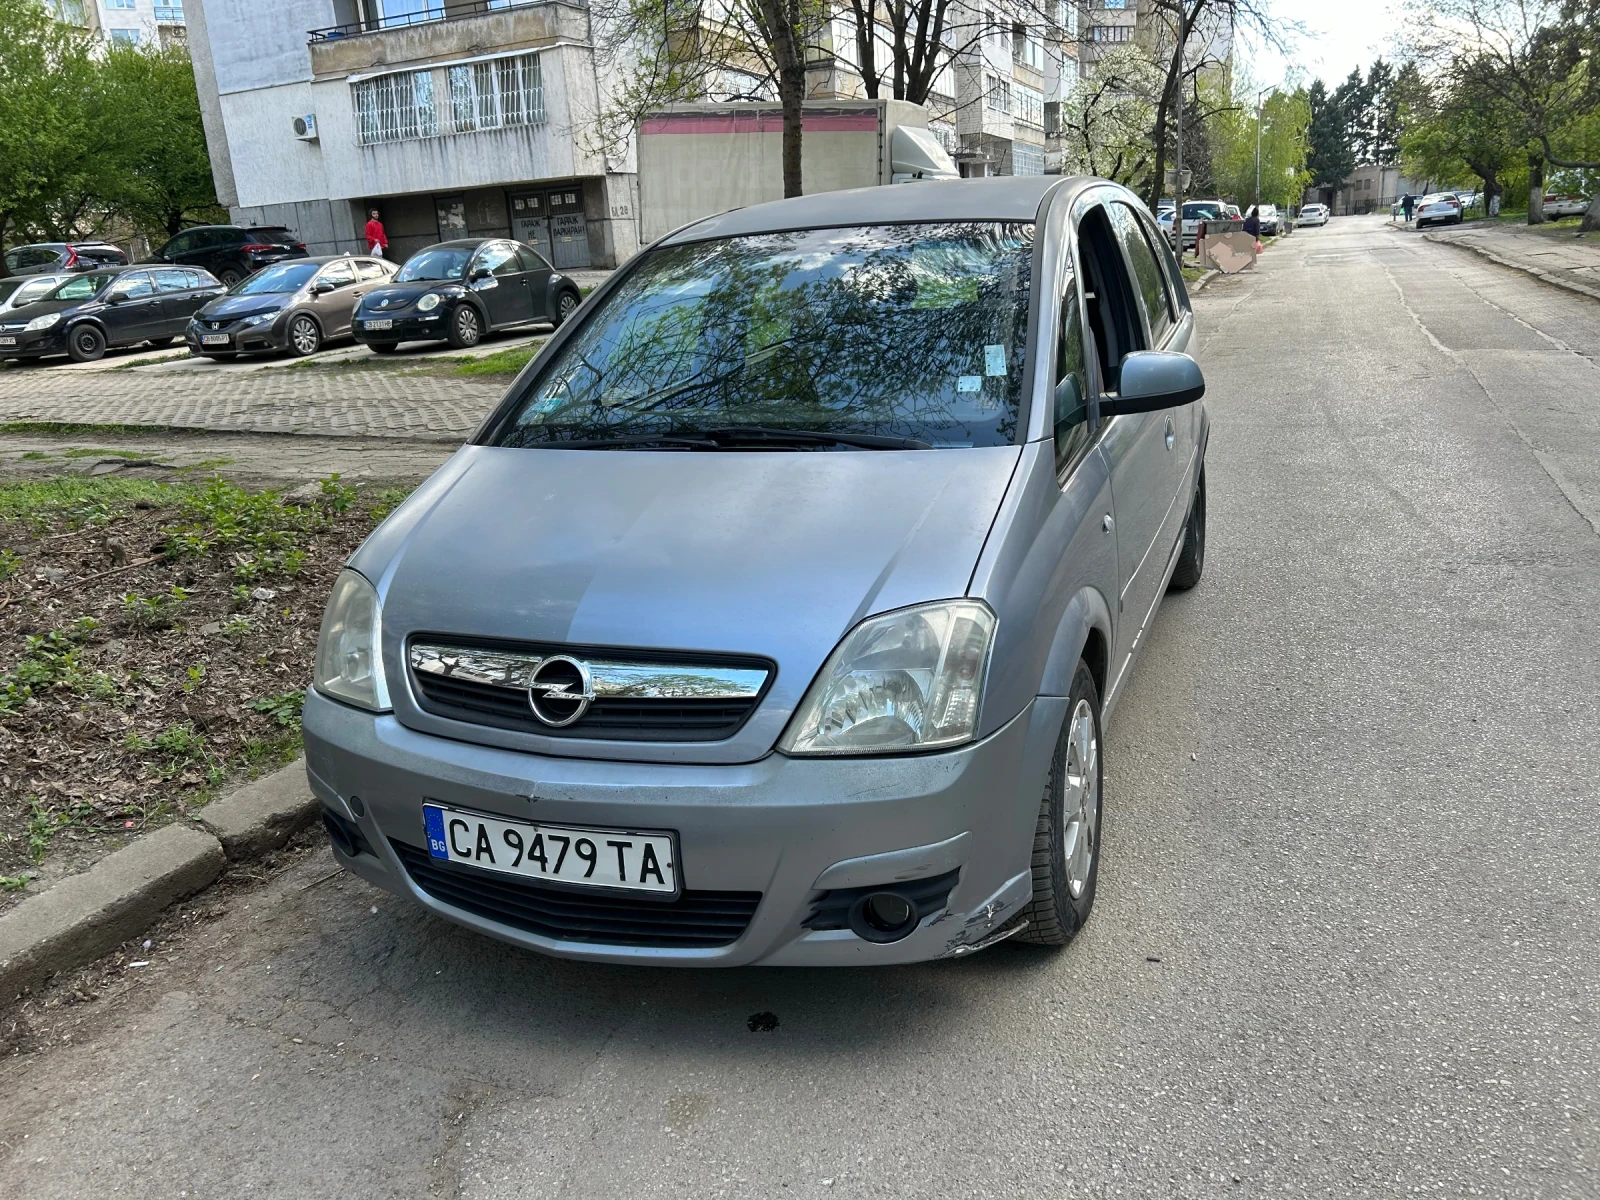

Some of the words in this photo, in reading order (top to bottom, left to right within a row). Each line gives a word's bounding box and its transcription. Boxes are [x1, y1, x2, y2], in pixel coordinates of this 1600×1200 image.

[521, 220, 540, 228] ГАРАЖ
[556, 216, 579, 226] ГАРАЖ
[528, 230, 536, 239] НЕ
[430, 838, 446, 852] BG
[503, 828, 598, 878] 9479
